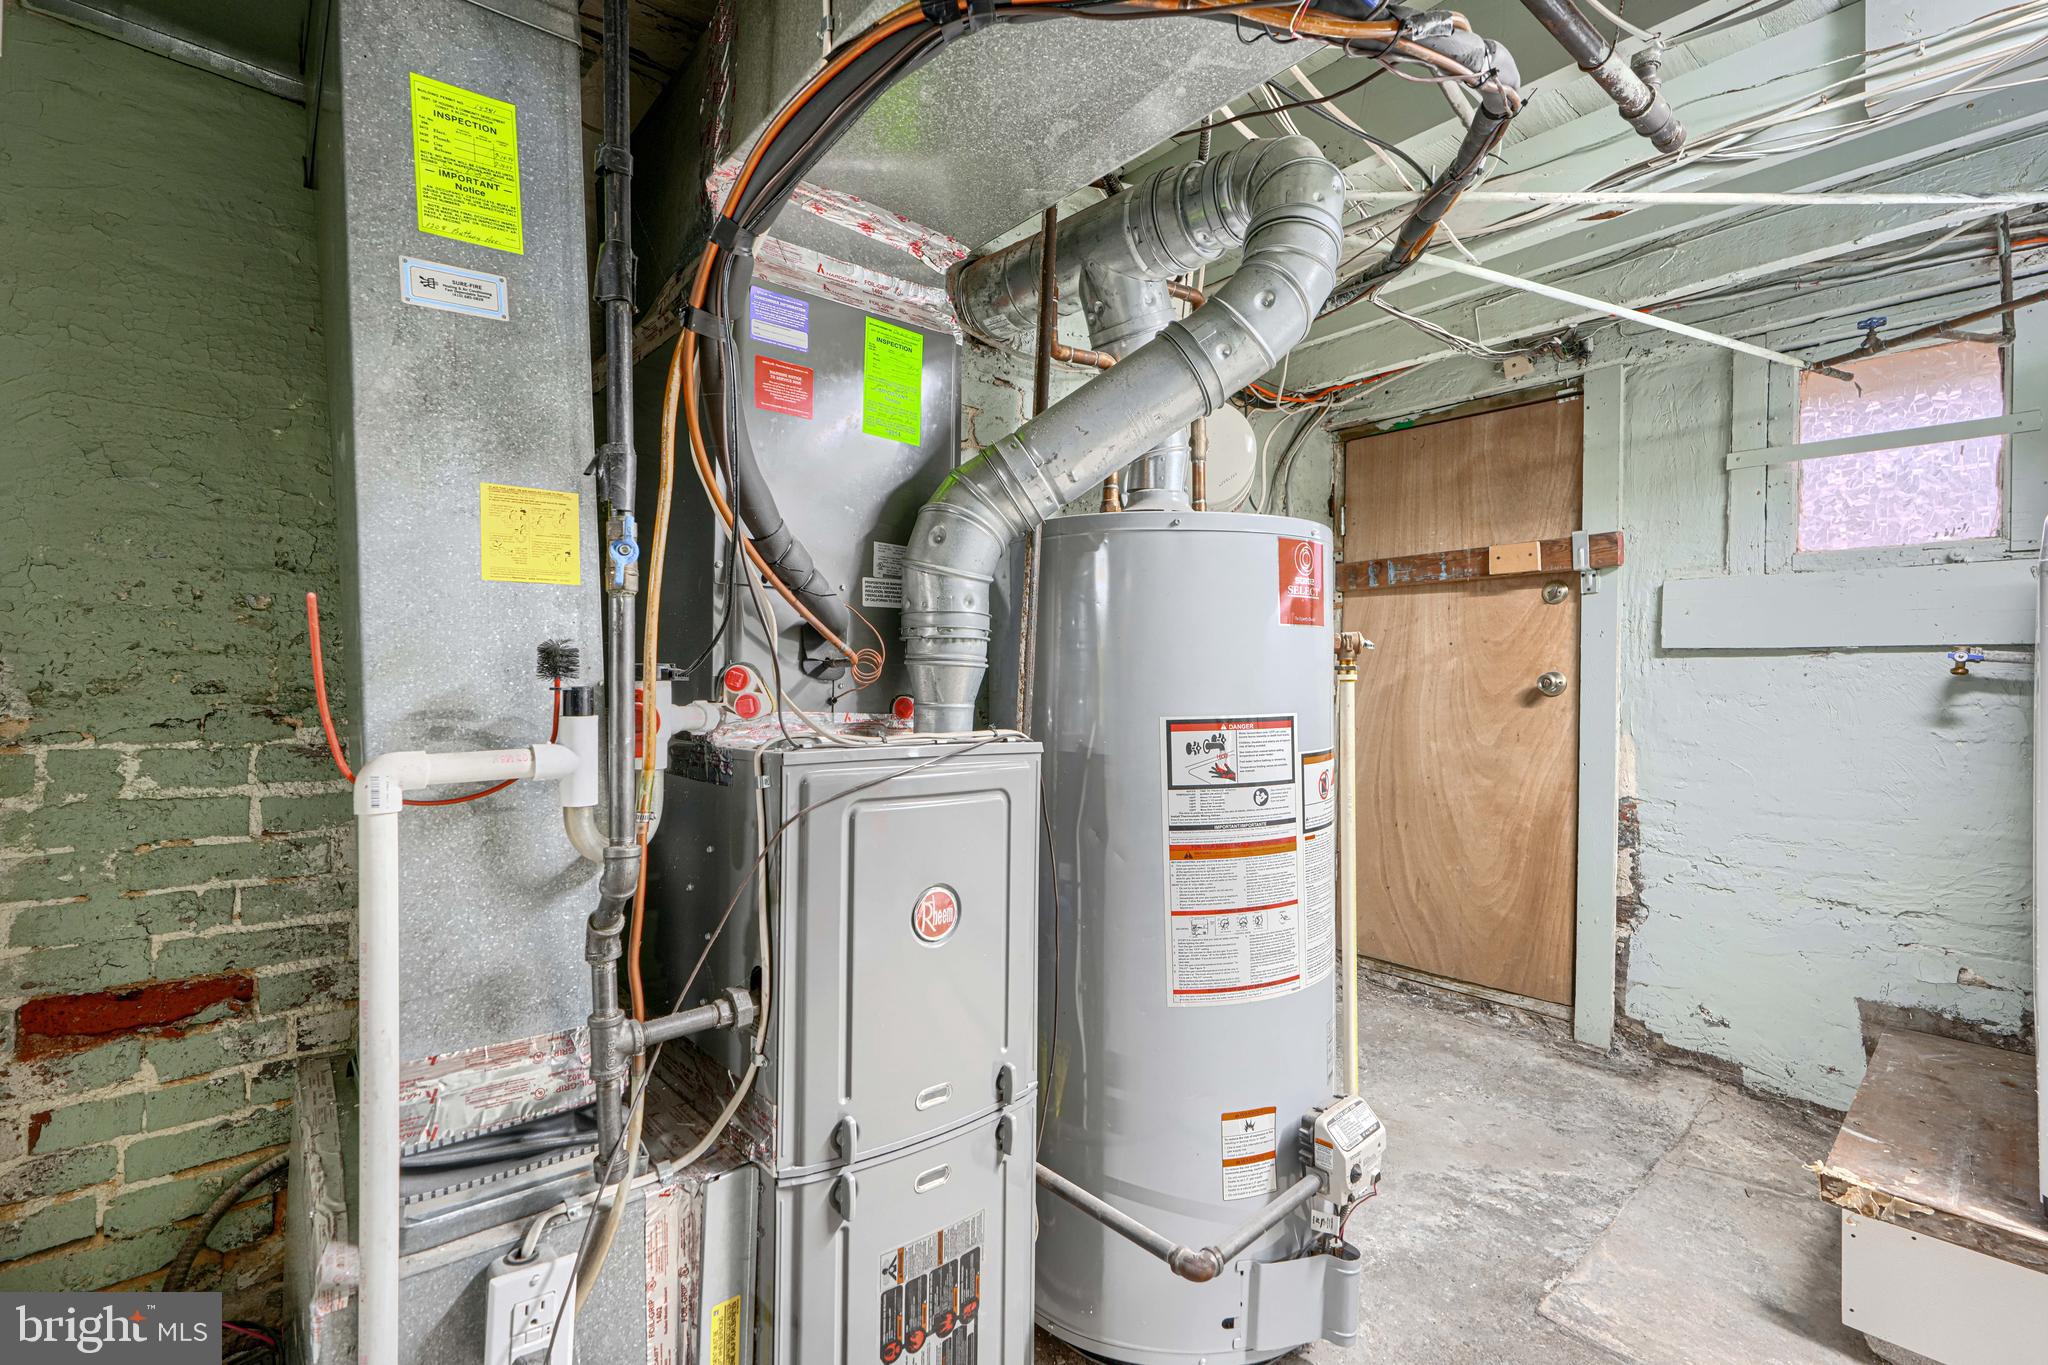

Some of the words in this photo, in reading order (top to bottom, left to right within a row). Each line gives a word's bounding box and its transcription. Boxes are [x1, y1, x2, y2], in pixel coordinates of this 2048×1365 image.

[433, 109, 497, 135] INSPECTION
[439, 168, 500, 192] IMPORTANT
[455, 182, 486, 197] Notice
[452, 280, 482, 290] SURE-FIRE
[876, 336, 912, 353] INSPECTION
[1287, 585, 1320, 597] SELECT
[920, 894, 954, 932] Rheem
[558, 1078, 592, 1094] OIL-GRIP
